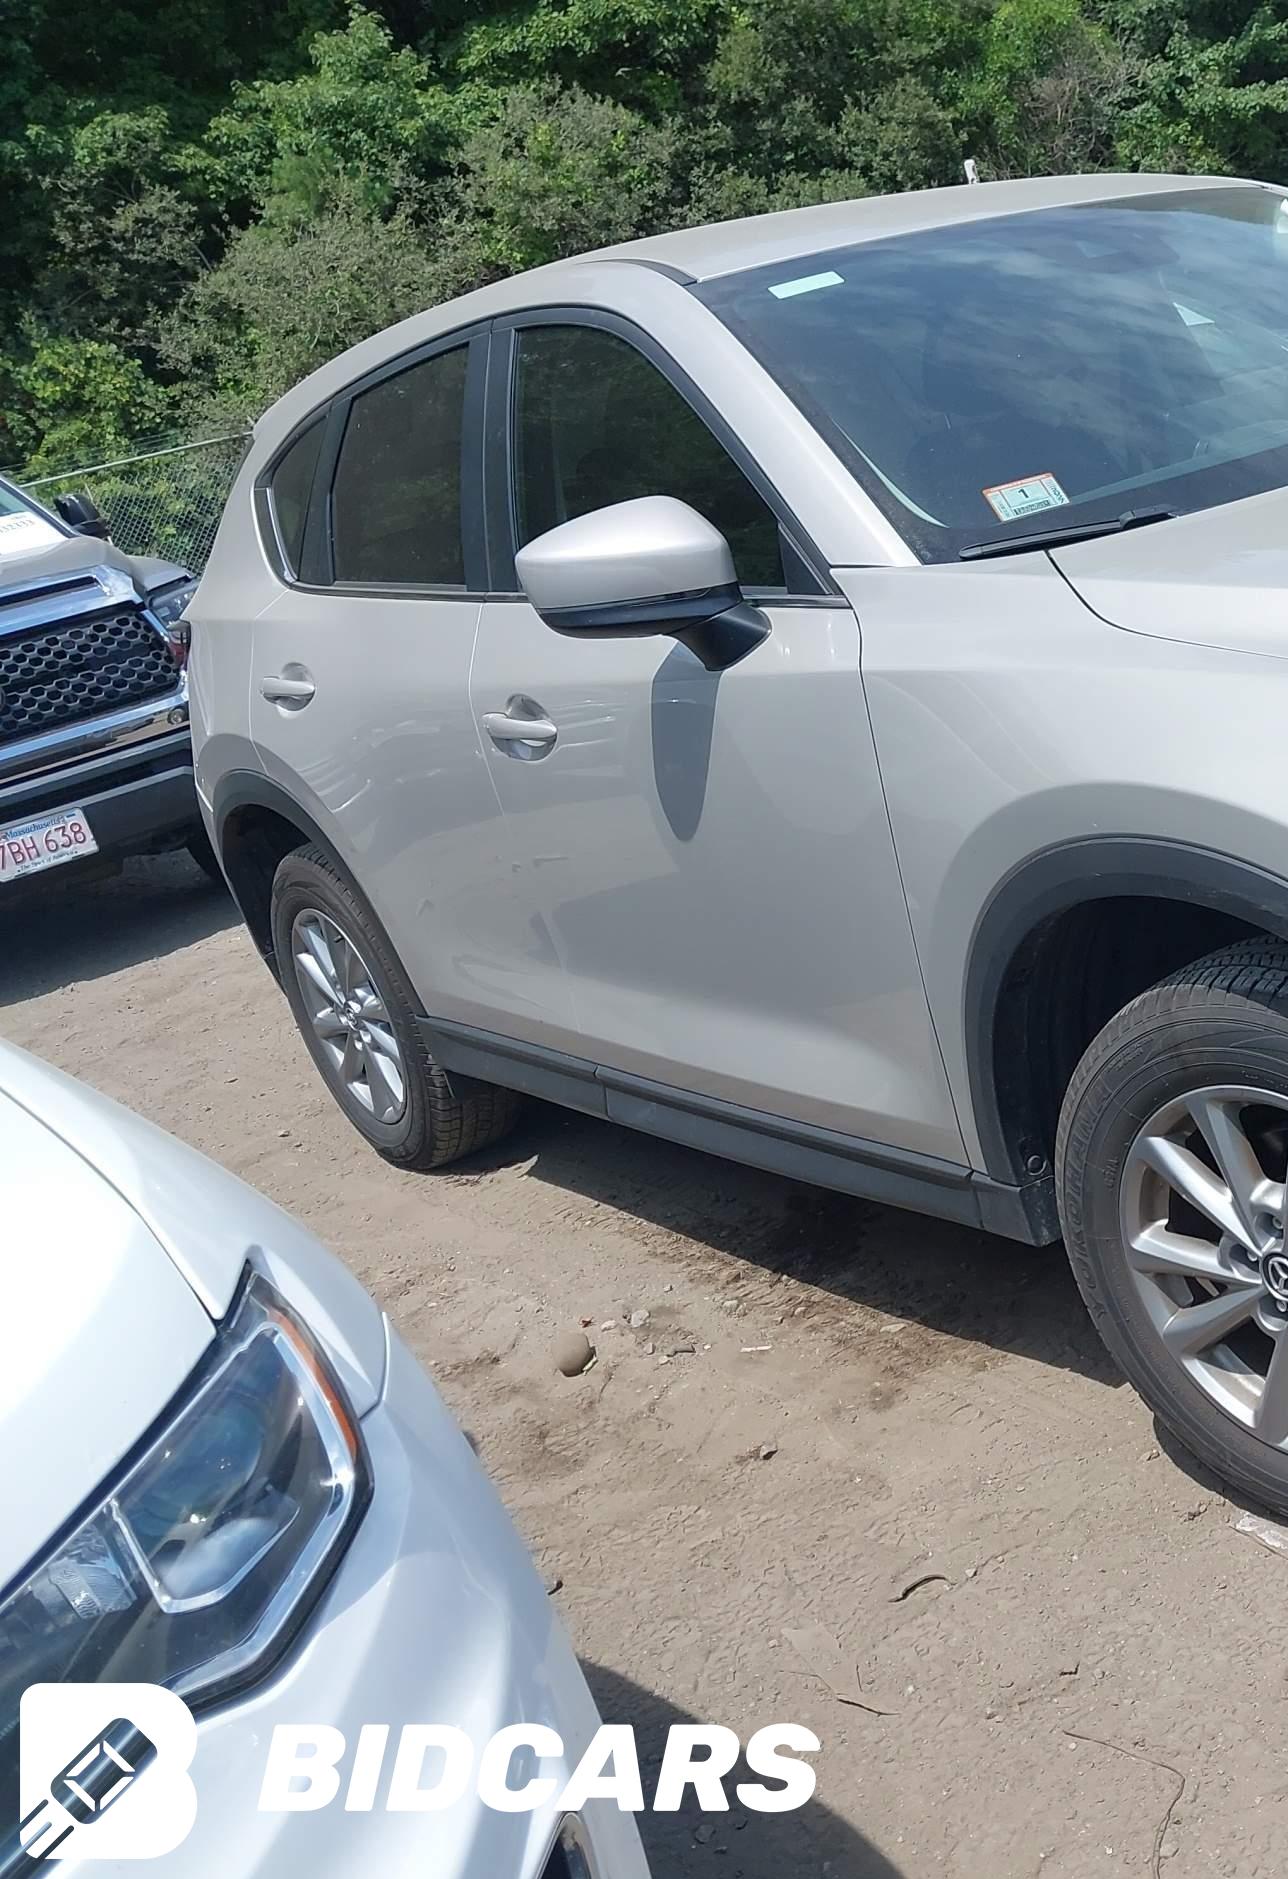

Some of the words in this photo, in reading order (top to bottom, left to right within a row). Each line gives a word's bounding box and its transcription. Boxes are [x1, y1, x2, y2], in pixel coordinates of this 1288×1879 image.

[1018, 488, 1029, 498] 1
[0, 836, 41, 871] 7BH
[45, 823, 86, 853] 638
